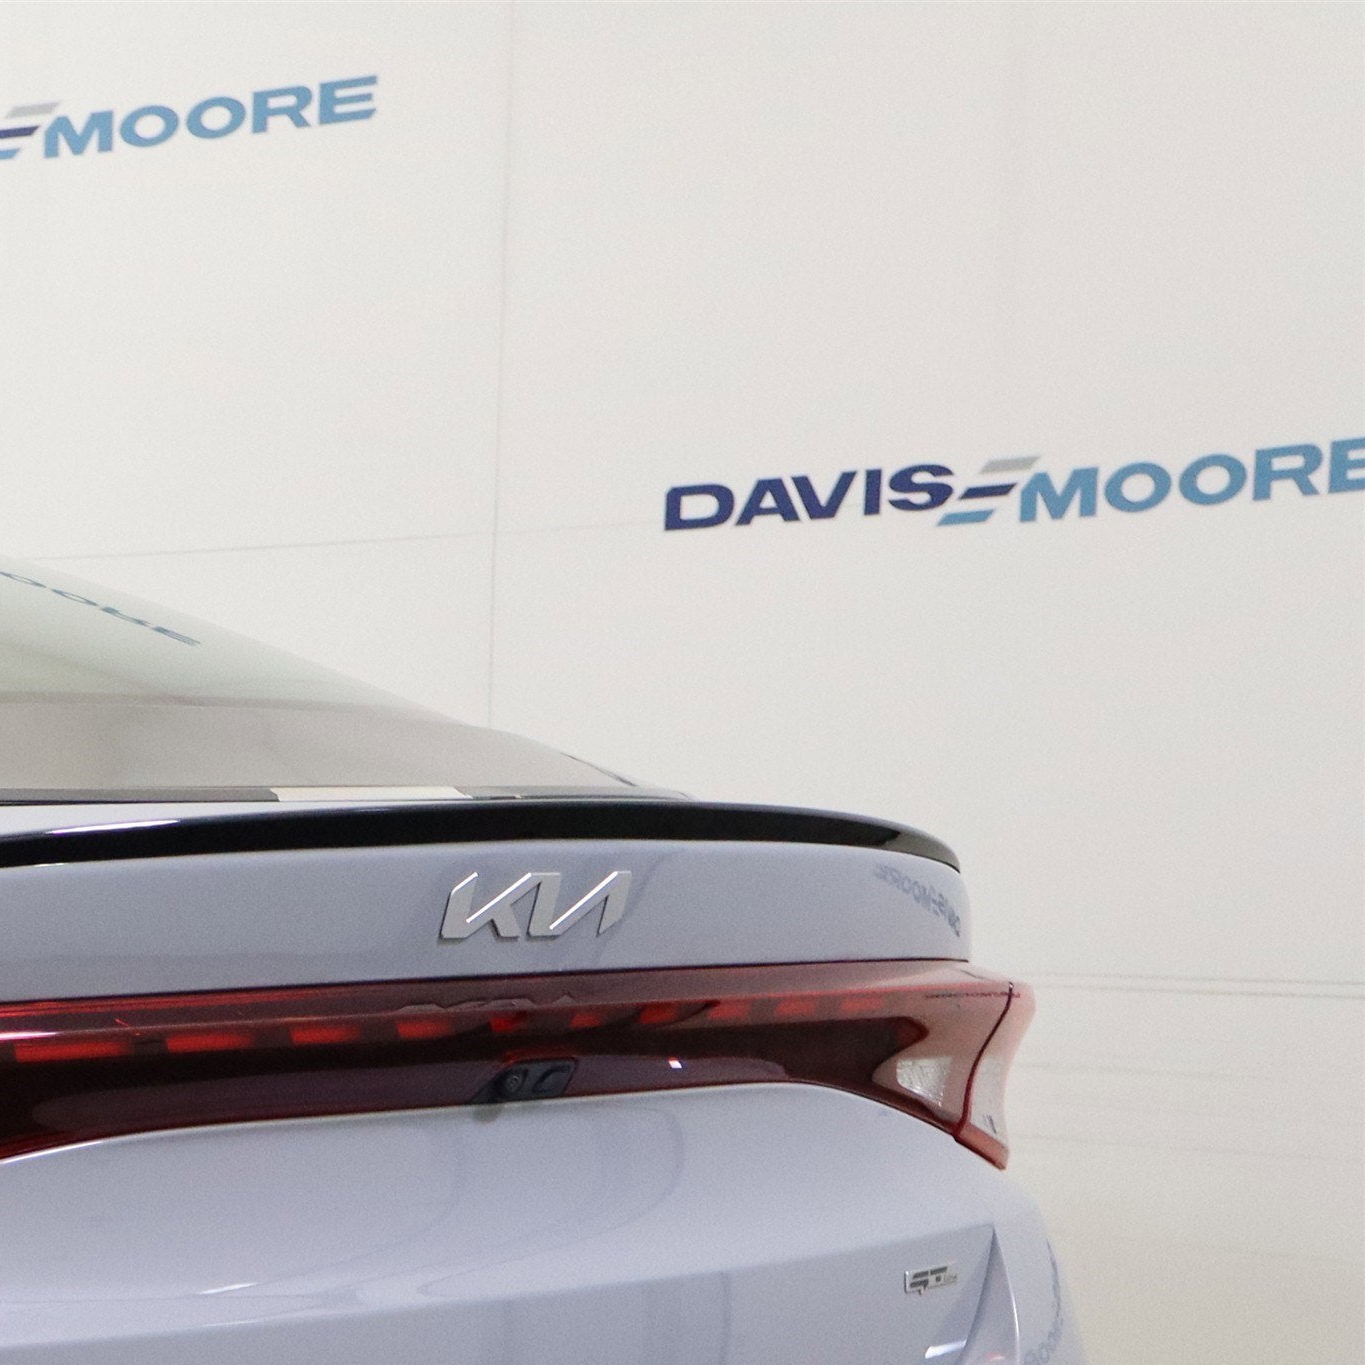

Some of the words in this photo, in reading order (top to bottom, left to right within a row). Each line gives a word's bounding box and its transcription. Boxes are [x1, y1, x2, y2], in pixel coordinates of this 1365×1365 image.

[43, 75, 379, 159] MOORE
[663, 462, 955, 530] DAVIS
[439, 871, 632, 940] KIA
